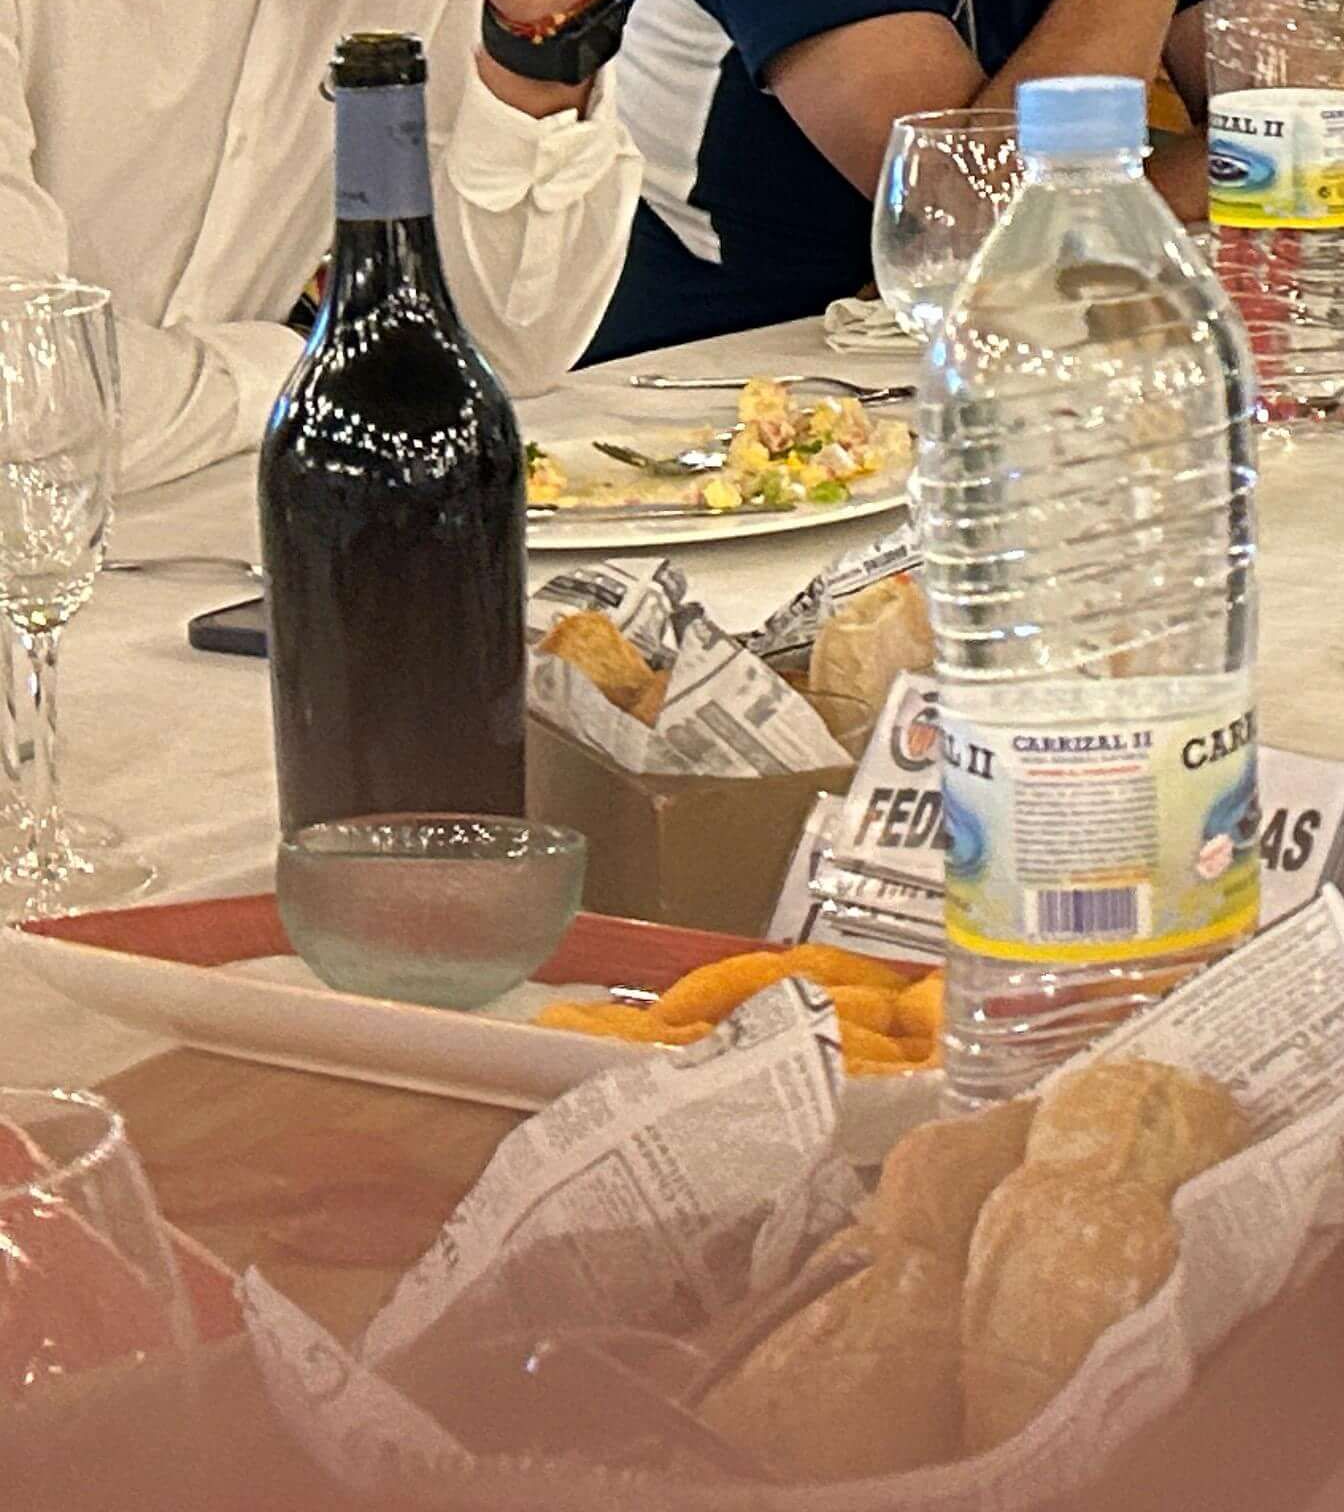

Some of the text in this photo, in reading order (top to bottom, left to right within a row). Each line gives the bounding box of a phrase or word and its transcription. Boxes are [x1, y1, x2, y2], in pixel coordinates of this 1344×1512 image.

[1263, 120, 1285, 138] II
[1012, 730, 1154, 753] CARRIZAL II
[967, 743, 996, 780] II
